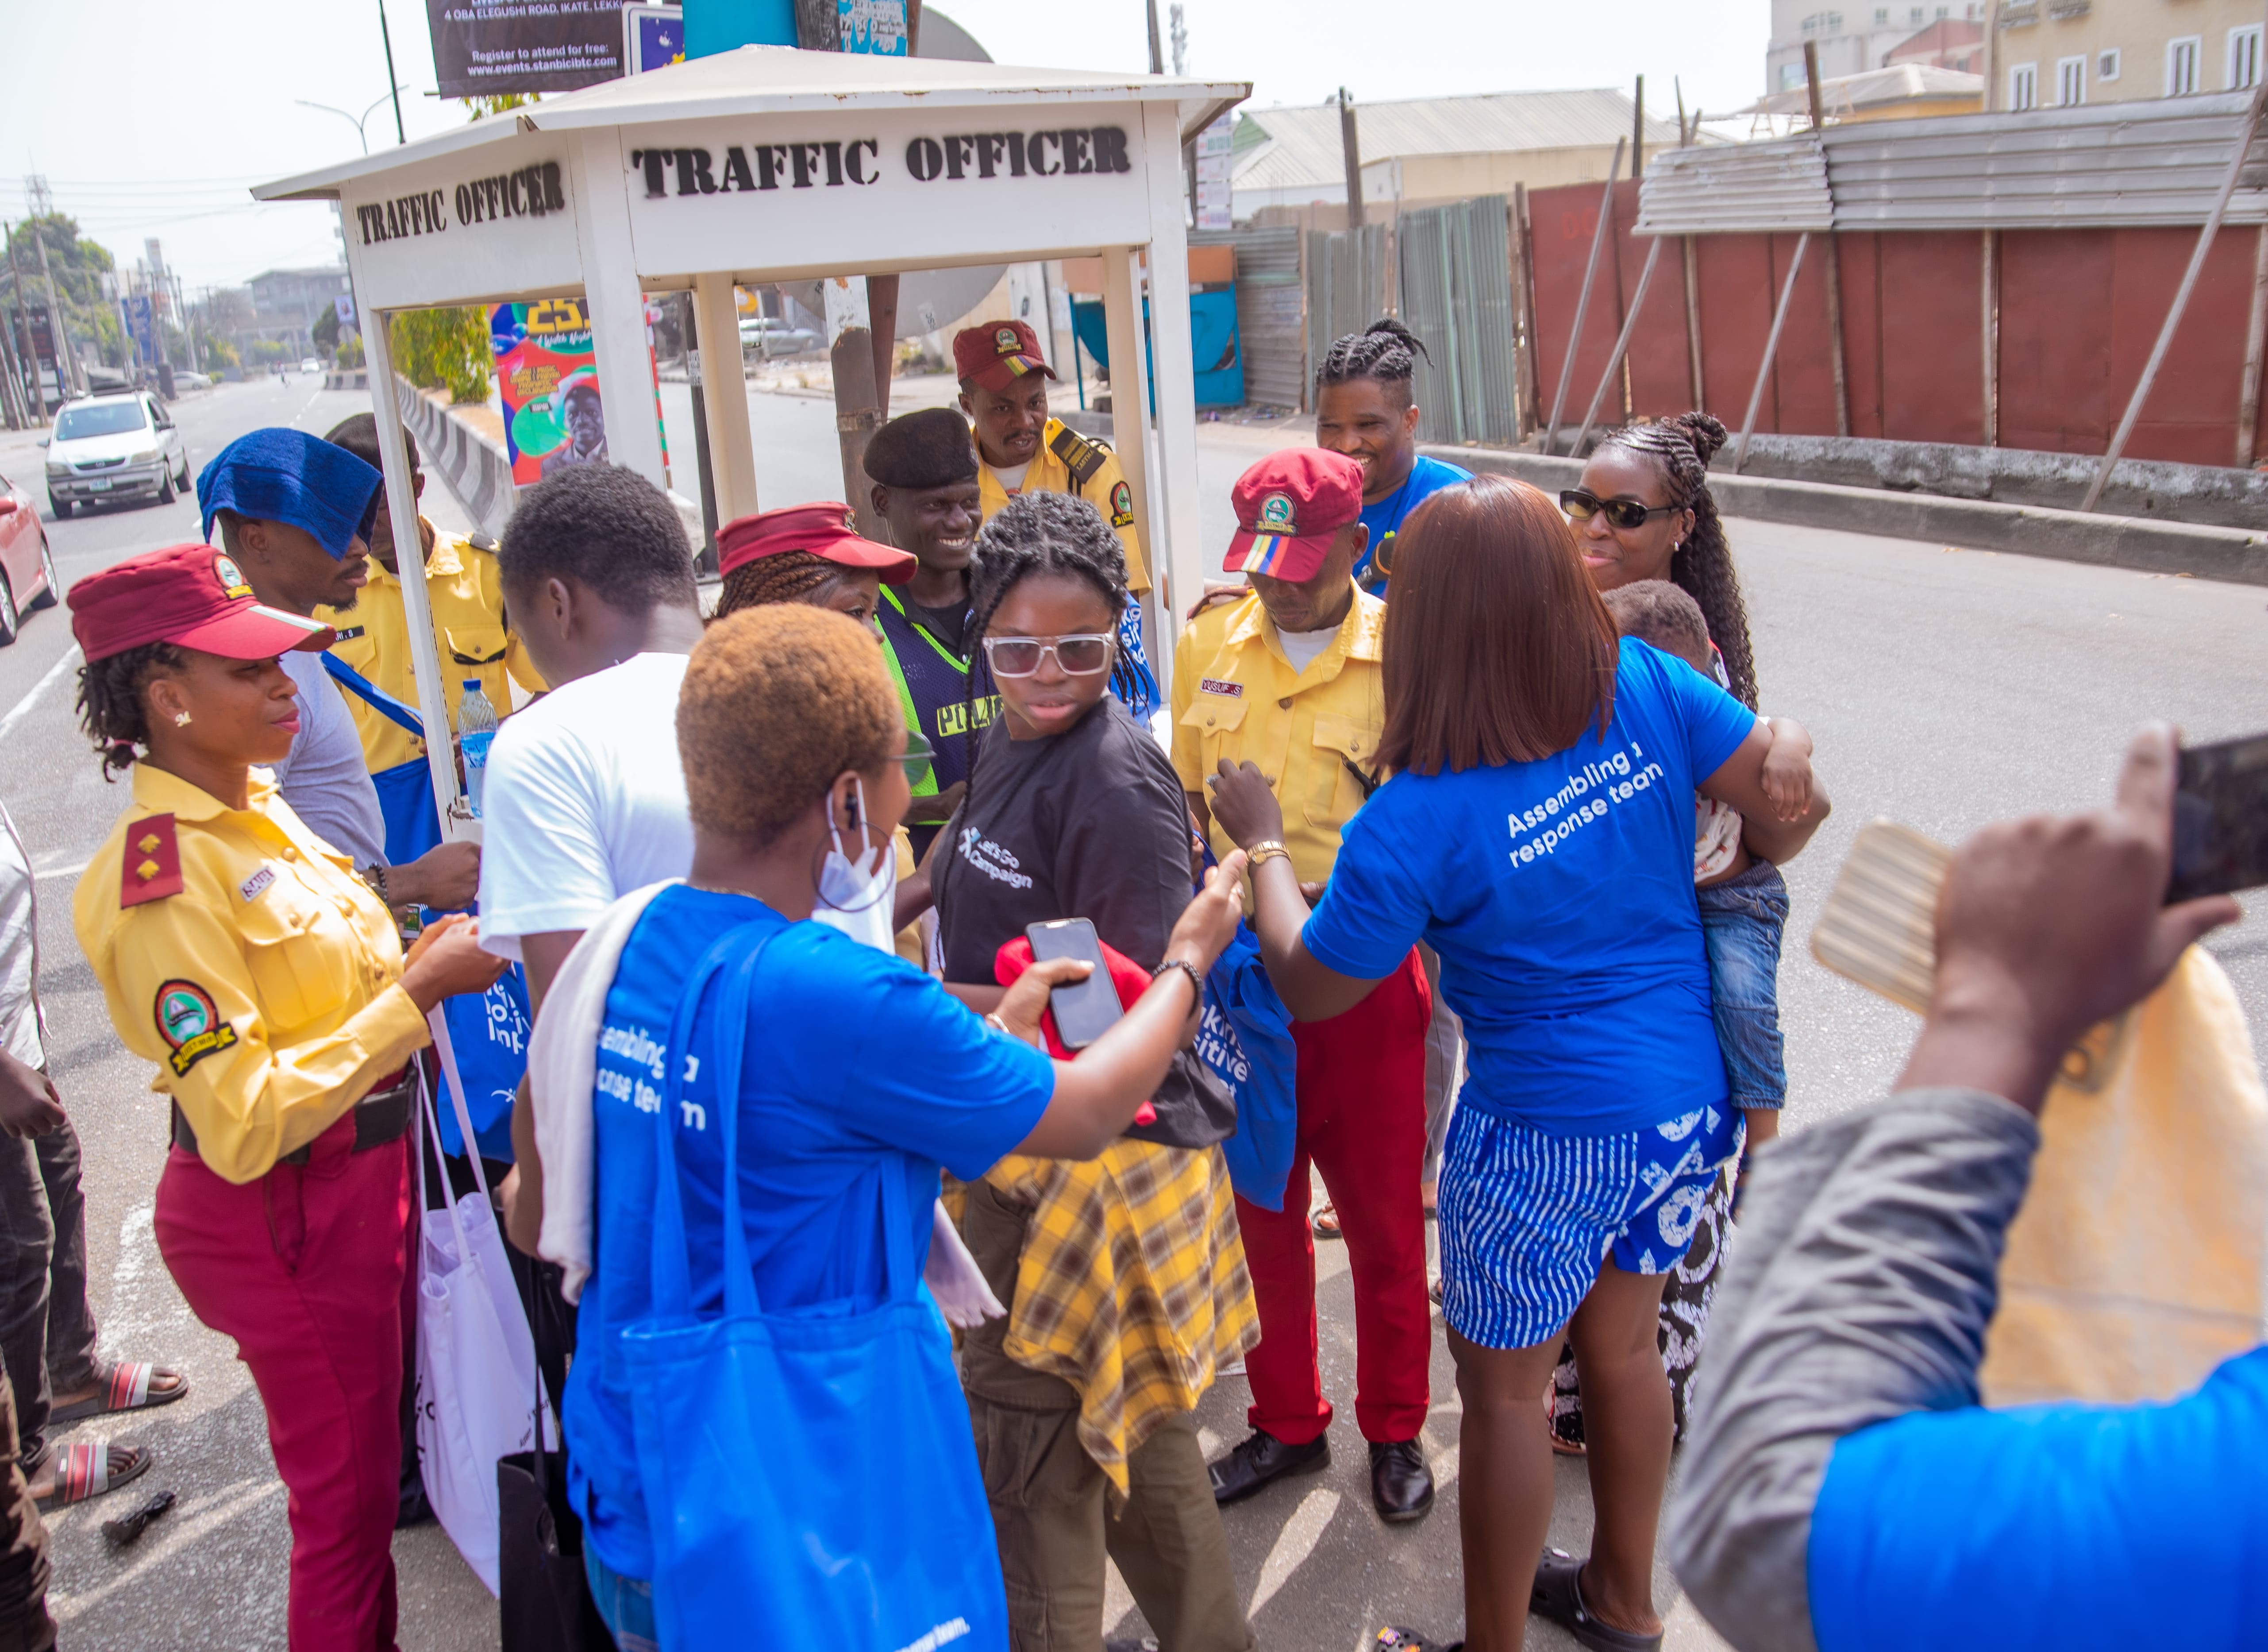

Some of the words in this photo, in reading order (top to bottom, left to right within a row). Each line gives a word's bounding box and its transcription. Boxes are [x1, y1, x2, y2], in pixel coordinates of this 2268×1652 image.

[445, 9, 452, 21] 4
[453, 8, 476, 21] OBA
[477, 5, 526, 21] ELEGUSHI
[467, 56, 618, 77] www.events.stanbicibtc.com
[472, 49, 515, 64] Register
[518, 47, 530, 60] to
[531, 44, 566, 58] attend
[567, 43, 582, 57] for
[584, 42, 609, 55] free:
[632, 139, 880, 199] TRAFFIC
[905, 127, 1131, 181] OFFICER
[357, 189, 447, 245] TRAFFIC
[455, 161, 565, 227] OFFICER
[1202, 680, 1229, 693] YUSUF
[1508, 750, 1631, 839] Assembling
[1509, 798, 1608, 868] response
[599, 1025, 666, 1080] embling
[596, 1067, 633, 1102] onse
